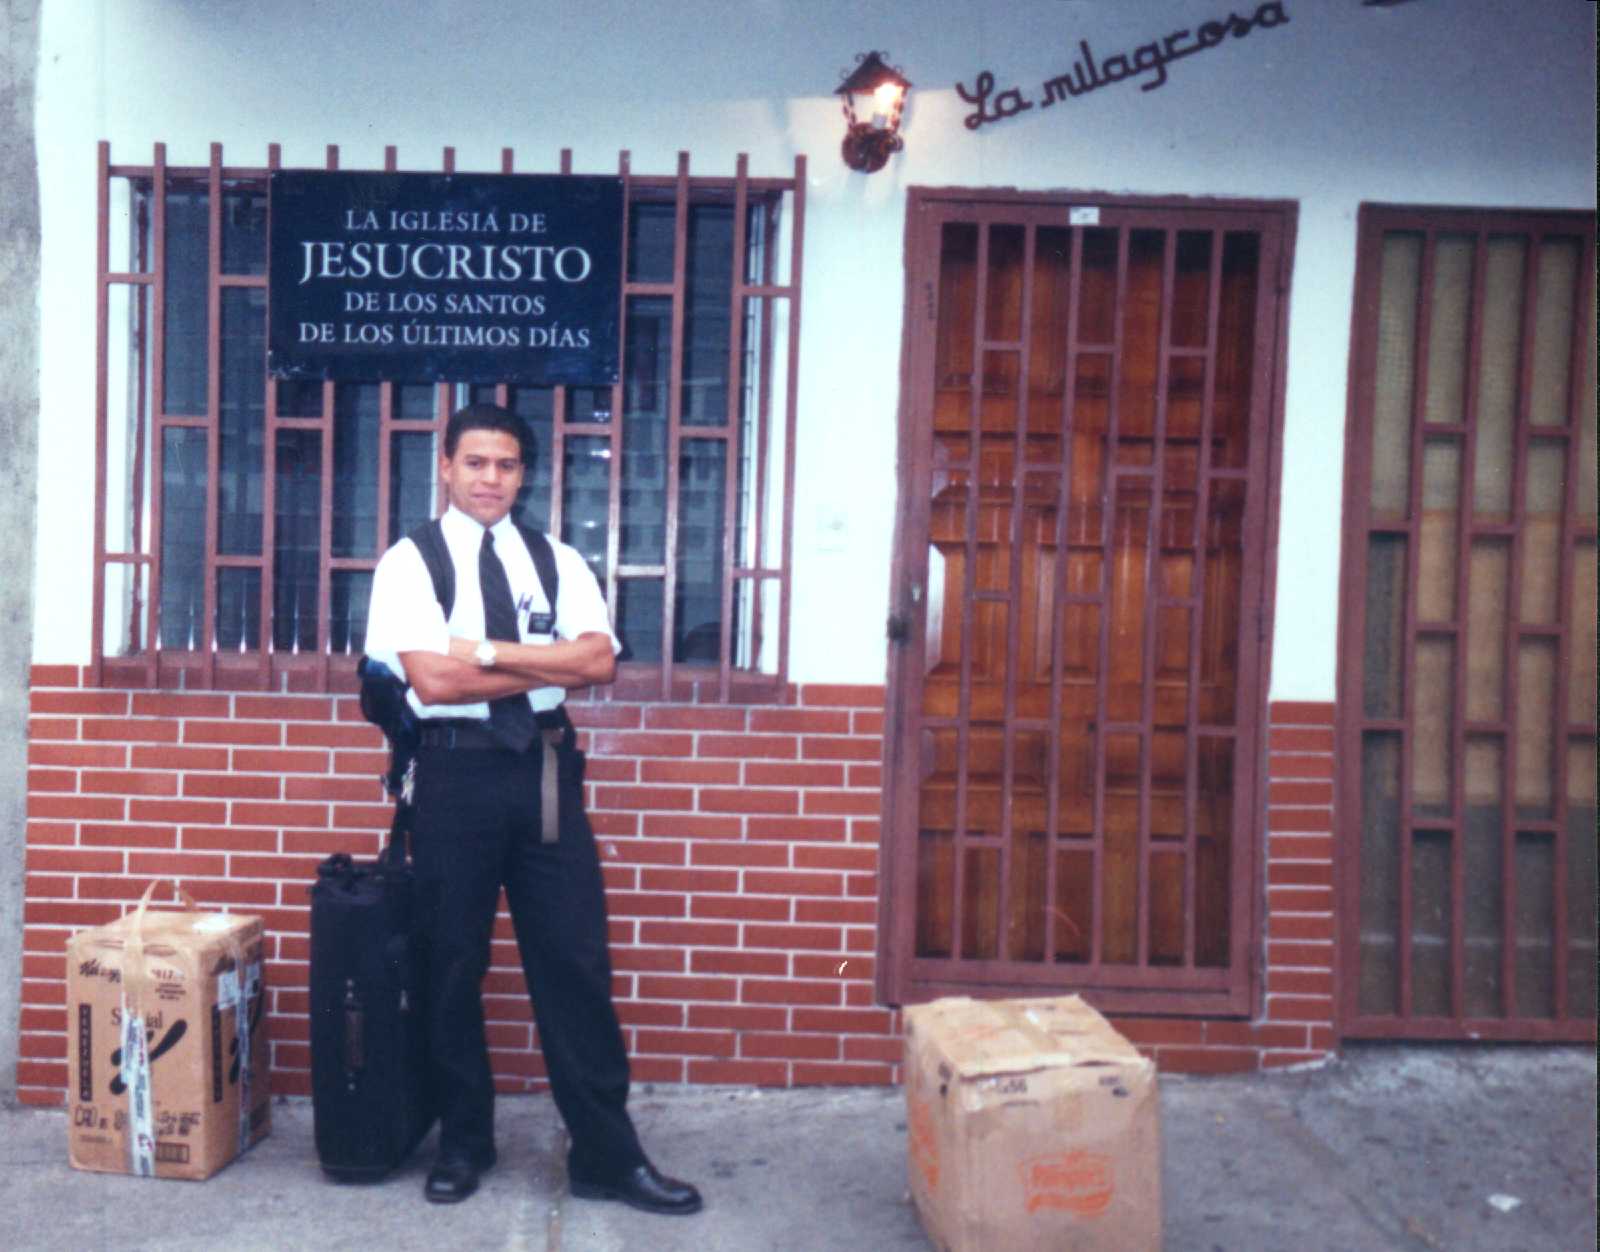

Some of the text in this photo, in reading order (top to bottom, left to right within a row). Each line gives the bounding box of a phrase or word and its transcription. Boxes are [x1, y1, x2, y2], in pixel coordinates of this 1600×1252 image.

[955, 0, 1291, 131] La milagrosa
[345, 209, 380, 231] LA
[509, 212, 547, 234] DE
[299, 241, 592, 285] JESUCRISTO
[344, 291, 547, 316] DE LOS SANTOS
[299, 318, 591, 349] DE LOS ÚLTIMOS DÍAS
